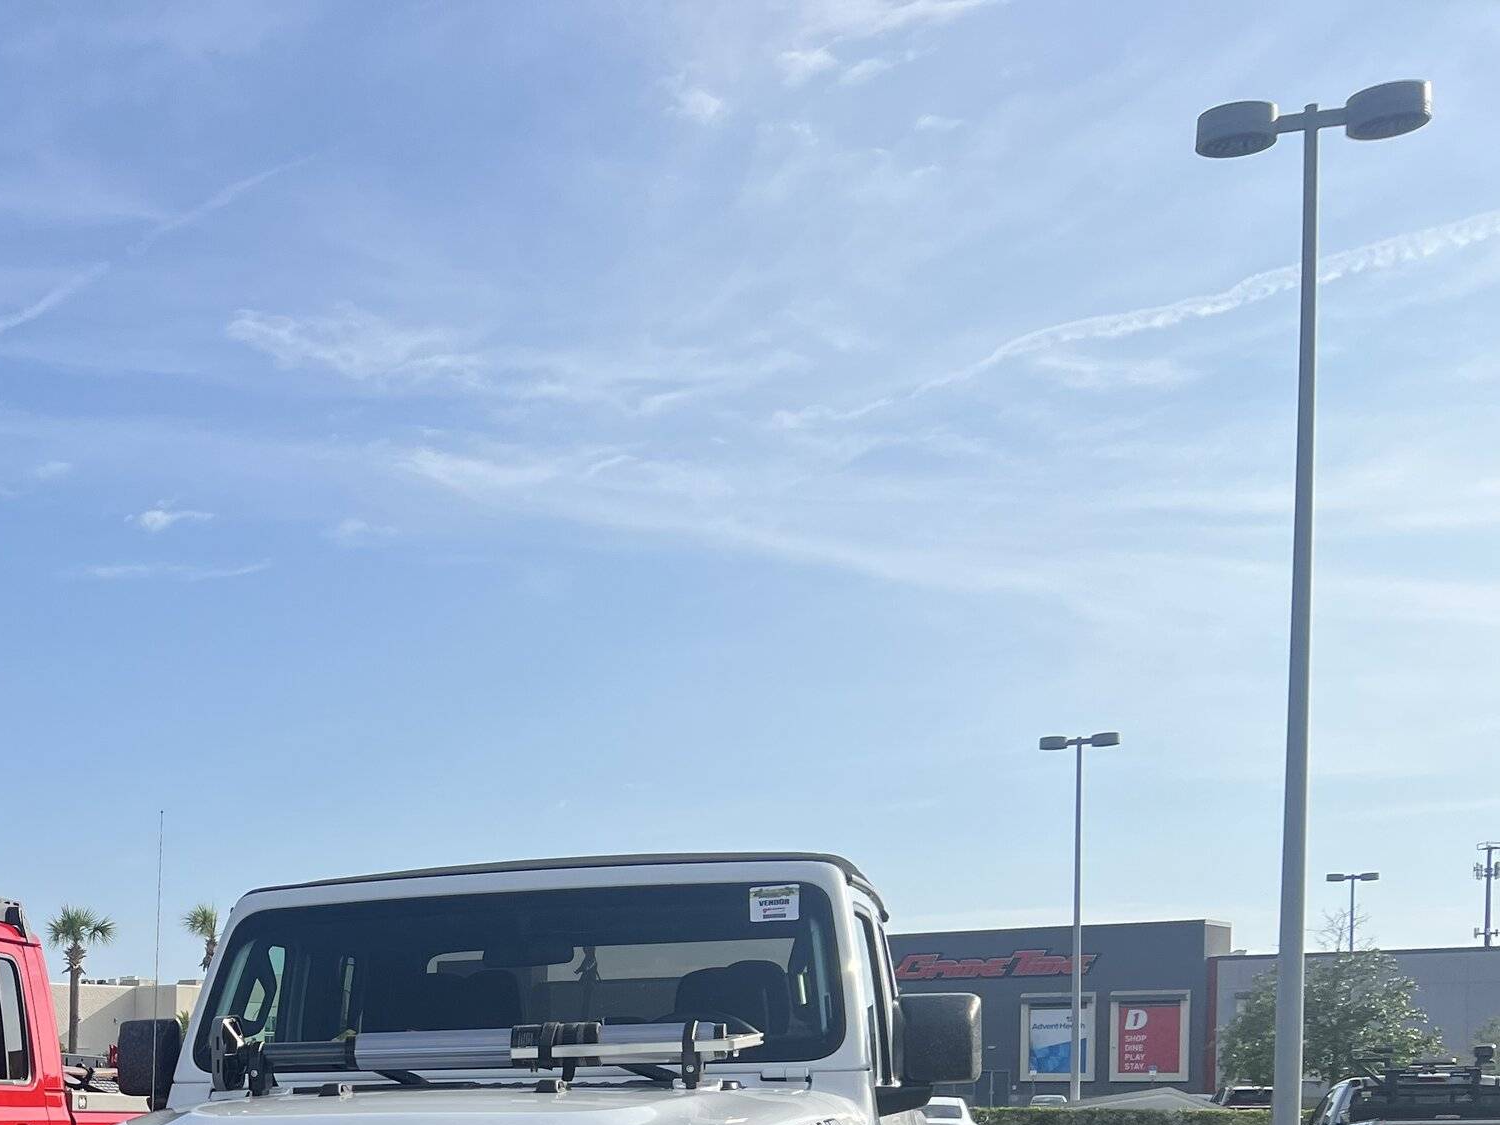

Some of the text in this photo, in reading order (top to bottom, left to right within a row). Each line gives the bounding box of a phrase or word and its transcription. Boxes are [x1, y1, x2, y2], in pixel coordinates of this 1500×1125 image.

[1124, 1034, 1147, 1043] SHOP
[1124, 1044, 1144, 1052] DINE
[1124, 1053, 1146, 1061] PLAY
[1124, 1062, 1145, 1071] STAY
